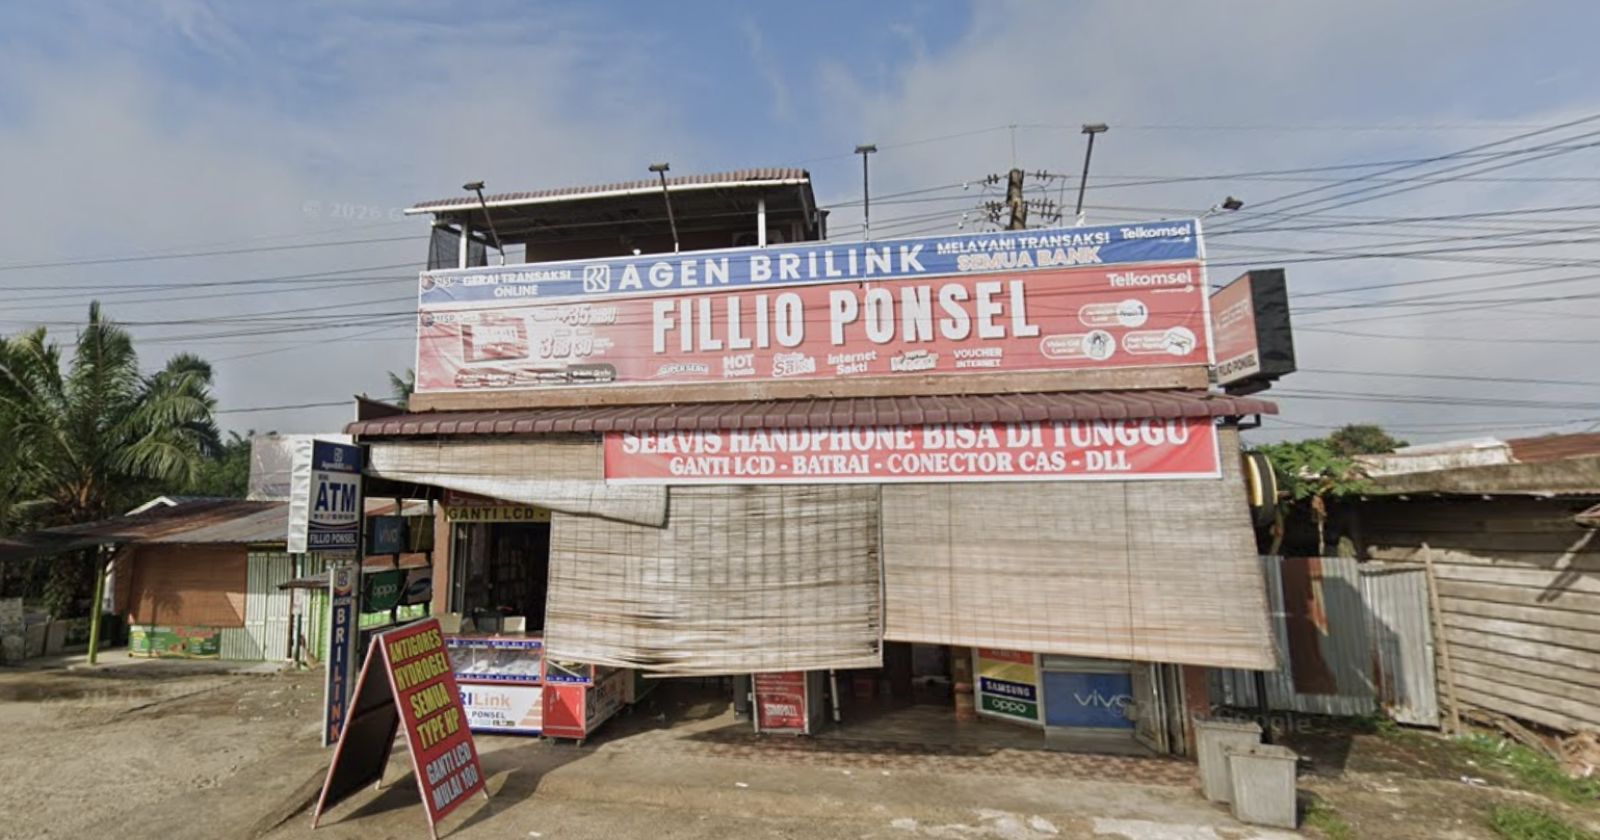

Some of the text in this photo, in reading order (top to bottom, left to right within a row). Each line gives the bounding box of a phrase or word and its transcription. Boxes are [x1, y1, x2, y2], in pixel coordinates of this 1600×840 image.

[1120, 224, 1191, 240] Telkomsel
[937, 232, 1110, 255] MELAYANI TRANSAKSI
[618, 244, 925, 290] AGEN BRILINK
[957, 246, 1102, 271] SEMUA BANK
[463, 270, 571, 286] GERAI TRANSAKSI
[1106, 270, 1192, 287] Telkomsel
[494, 285, 539, 297] ONLINE
[653, 279, 1039, 353] FILLIO PONSEL
[723, 354, 755, 369] HOT
[827, 351, 877, 365] Internet
[953, 348, 1003, 358] VOUCHER
[836, 362, 867, 374] Sakti
[956, 359, 1000, 368] INTERNET
[622, 429, 722, 454] SERVIS
[729, 426, 915, 452] HANDPHONE
[922, 421, 999, 450] BISA
[1007, 420, 1044, 448] DI
[669, 456, 730, 476] GANTI
[734, 456, 775, 475] LCD
[792, 454, 870, 475] BATRAI
[887, 452, 1012, 473] CONECTOR
[1018, 452, 1065, 472] CAS
[1086, 450, 1131, 471] DLL
[315, 482, 356, 512] ATM
[448, 507, 497, 519] GANTI
[503, 508, 534, 519] LCD
[331, 533, 355, 544] PONSEL
[373, 584, 397, 598] oppo
[390, 629, 442, 664] ANTIGORES
[331, 608, 345, 741] BRILINK
[394, 652, 449, 691] HYDROGEL
[985, 681, 1030, 697] SAMSUNG
[410, 682, 450, 719] SEMUA
[992, 698, 1027, 714] oppo
[472, 711, 505, 719] PONSEL
[417, 707, 459, 749] TYPE HP
[426, 741, 472, 785] GANTI LCD
[432, 774, 463, 811] MULAI
